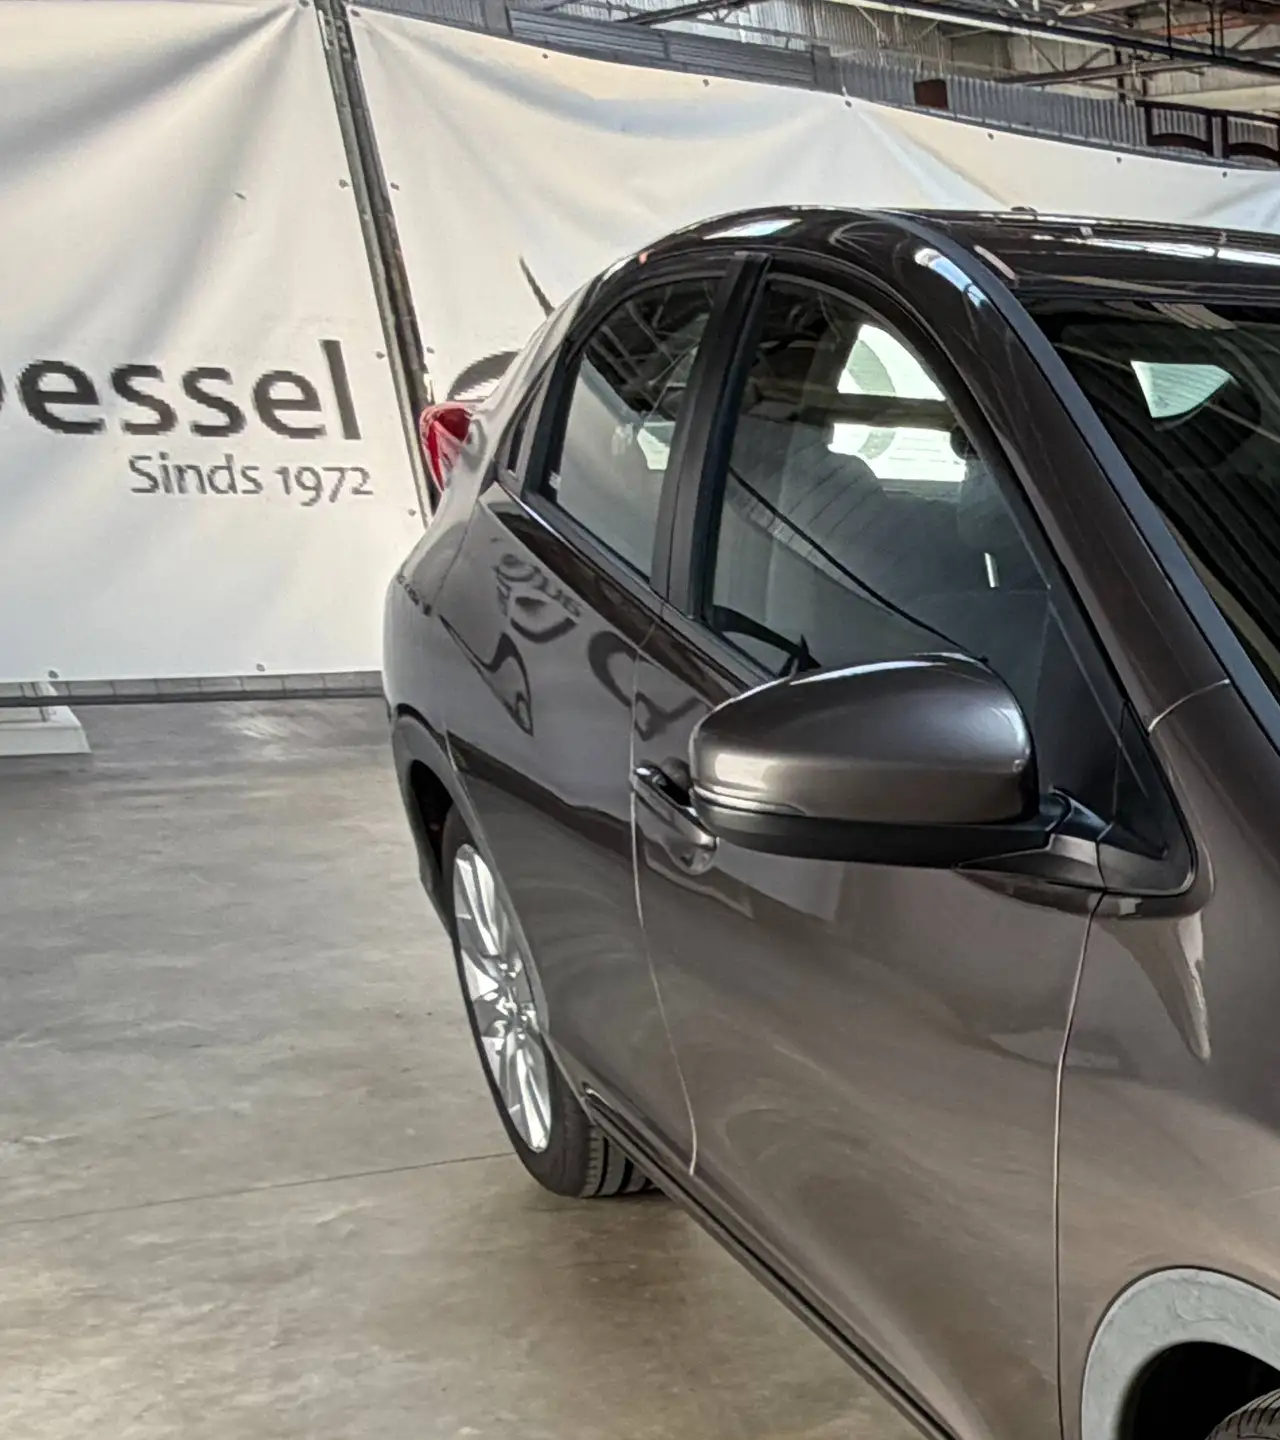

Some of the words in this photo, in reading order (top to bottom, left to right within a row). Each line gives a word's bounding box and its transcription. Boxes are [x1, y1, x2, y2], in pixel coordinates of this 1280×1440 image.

[0, 339, 362, 440] essel
[128, 451, 265, 496] Sinds
[274, 465, 375, 507] 1972
